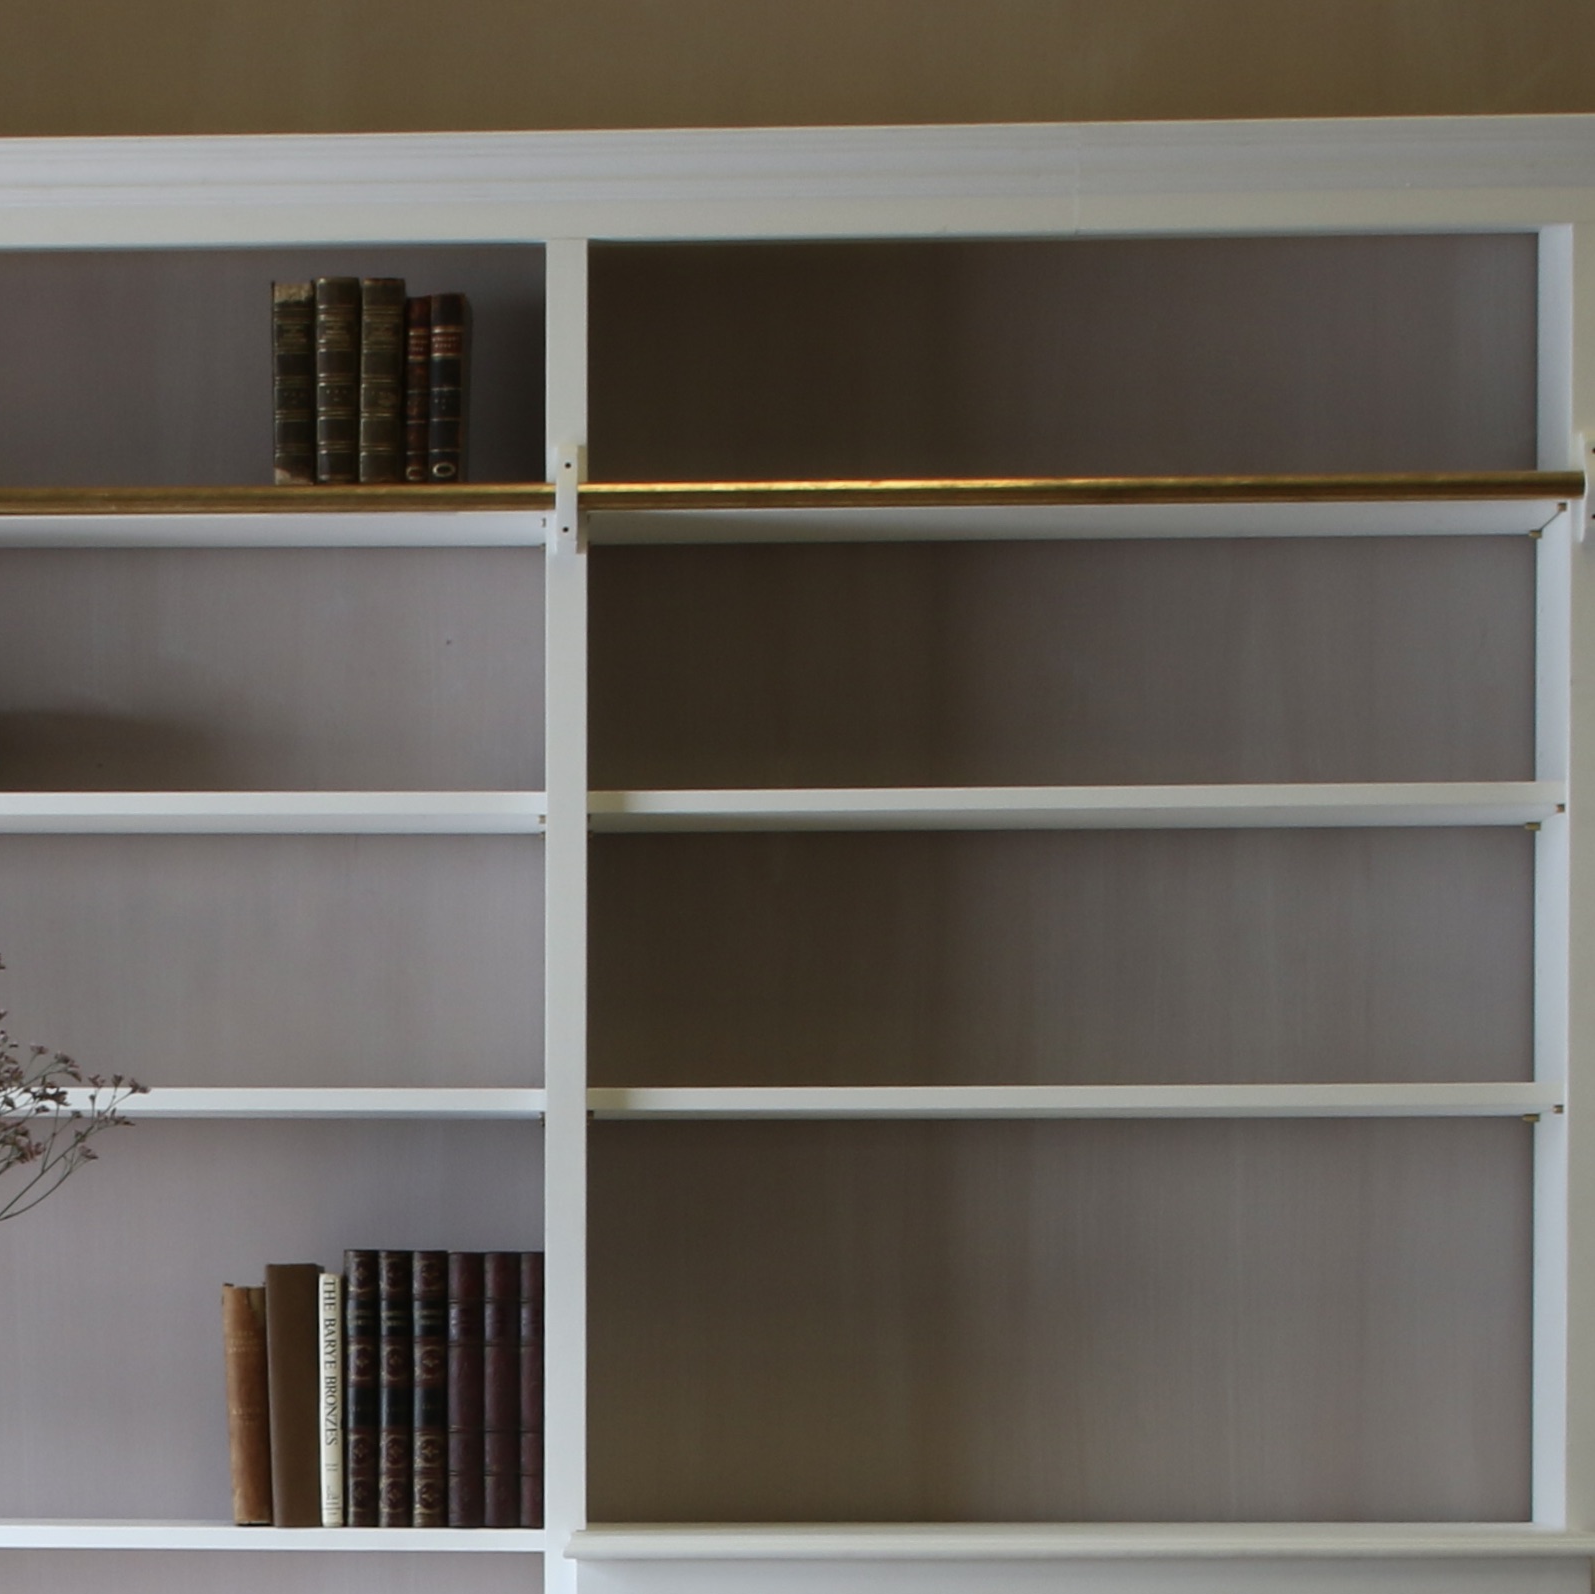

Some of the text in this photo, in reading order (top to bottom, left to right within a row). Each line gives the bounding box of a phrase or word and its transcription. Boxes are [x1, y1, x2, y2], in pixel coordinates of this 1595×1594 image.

[323, 1279, 337, 1311] THE
[323, 1318, 337, 1370] BARYE
[323, 1376, 338, 1446] BRONZES
